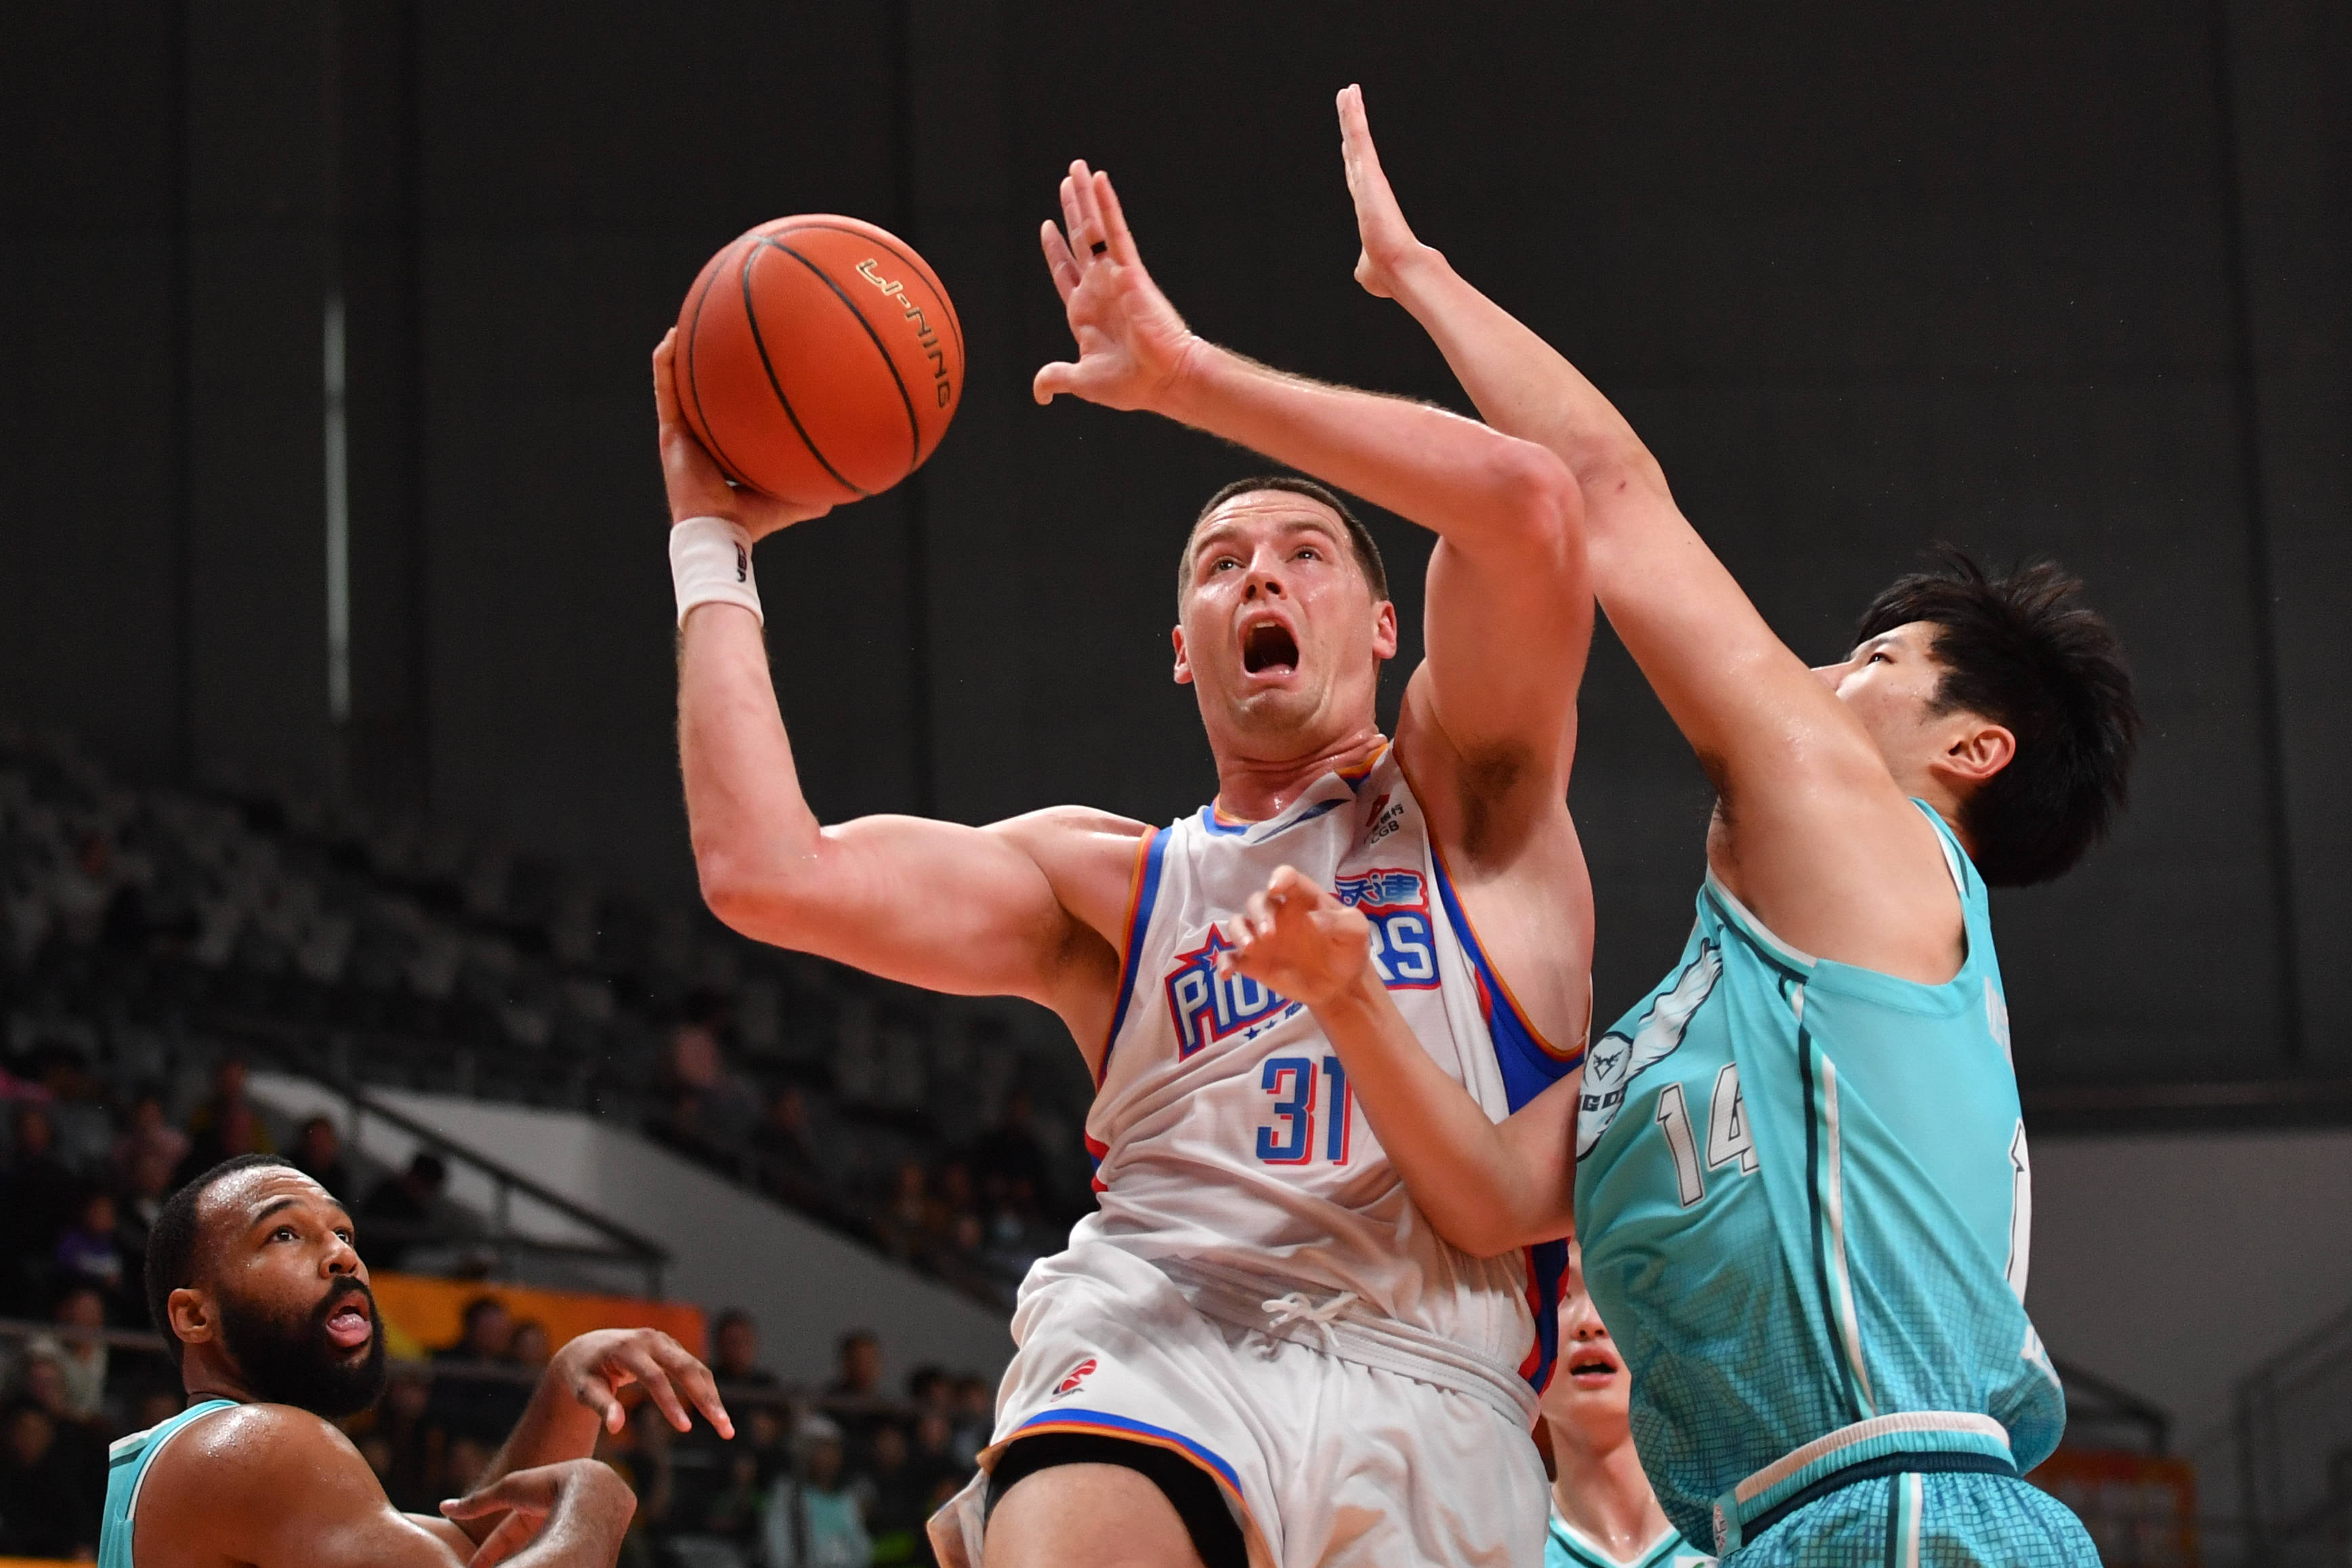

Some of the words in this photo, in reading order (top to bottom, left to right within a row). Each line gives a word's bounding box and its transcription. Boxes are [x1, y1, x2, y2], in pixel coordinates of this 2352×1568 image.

[856, 259, 950, 408] LI-NING
[1174, 916, 1435, 1047] PIORS
[1256, 1057, 1352, 1165] 31
[1656, 1061, 1761, 1210] 14
